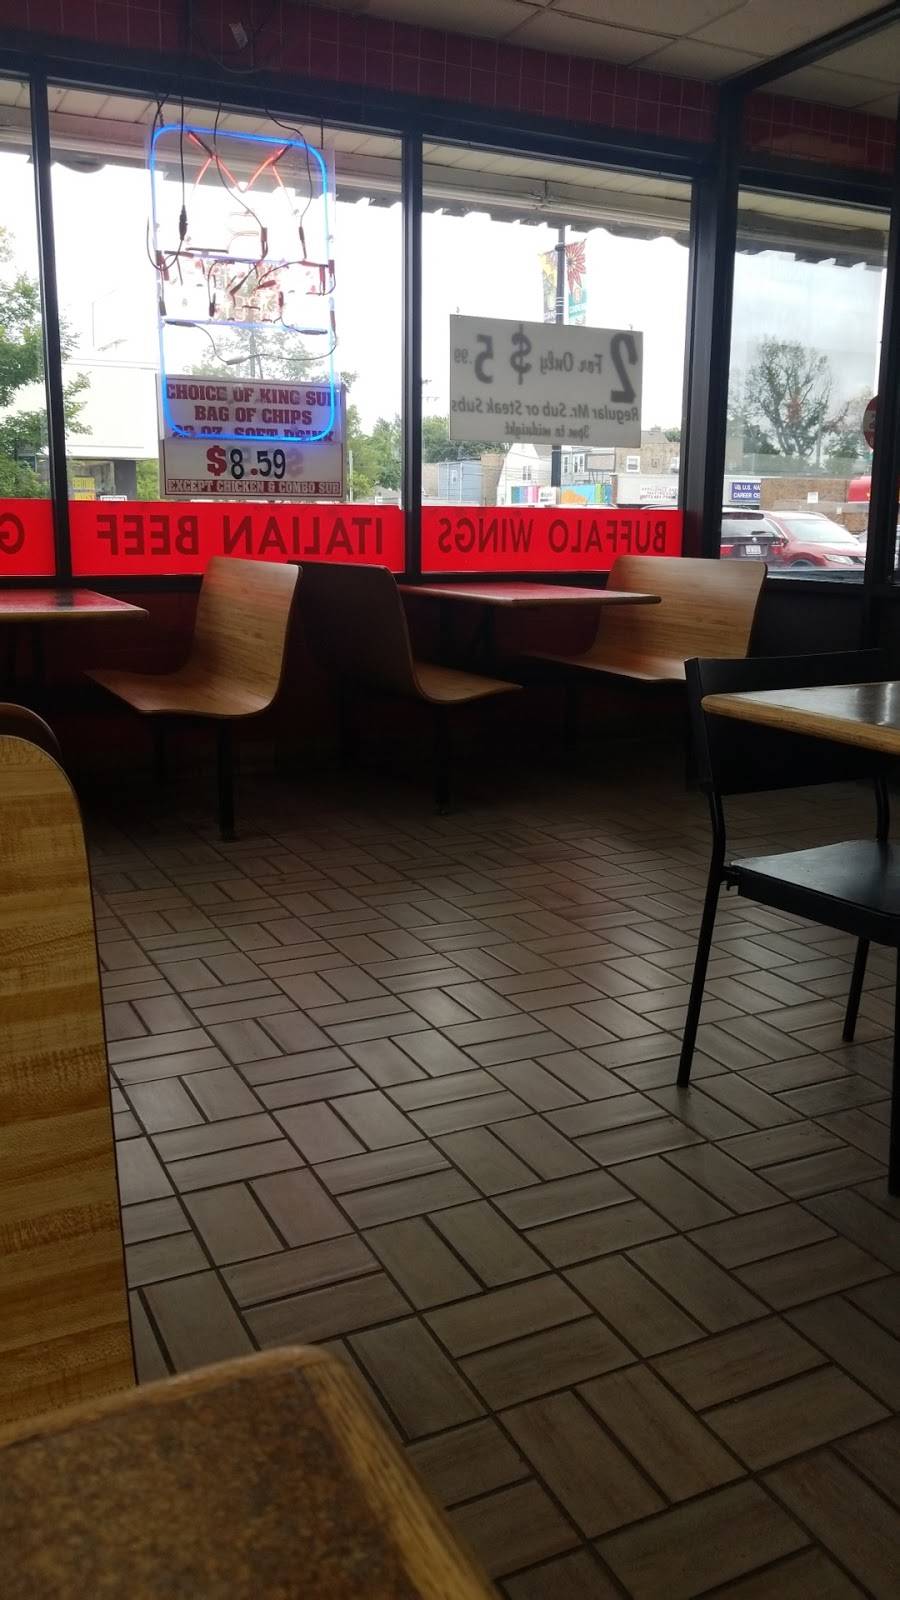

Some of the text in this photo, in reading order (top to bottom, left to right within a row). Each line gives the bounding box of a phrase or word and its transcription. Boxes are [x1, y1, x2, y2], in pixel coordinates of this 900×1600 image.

[166, 383, 227, 401] CHOICE
[232, 386, 254, 402] OF
[259, 388, 300, 405] KING
[194, 405, 313, 425] BAG OF CHIPS
[206, 445, 286, 479] $8.59
[168, 479, 341, 494] EXCEPT CHICKEN & COMBO SUB
